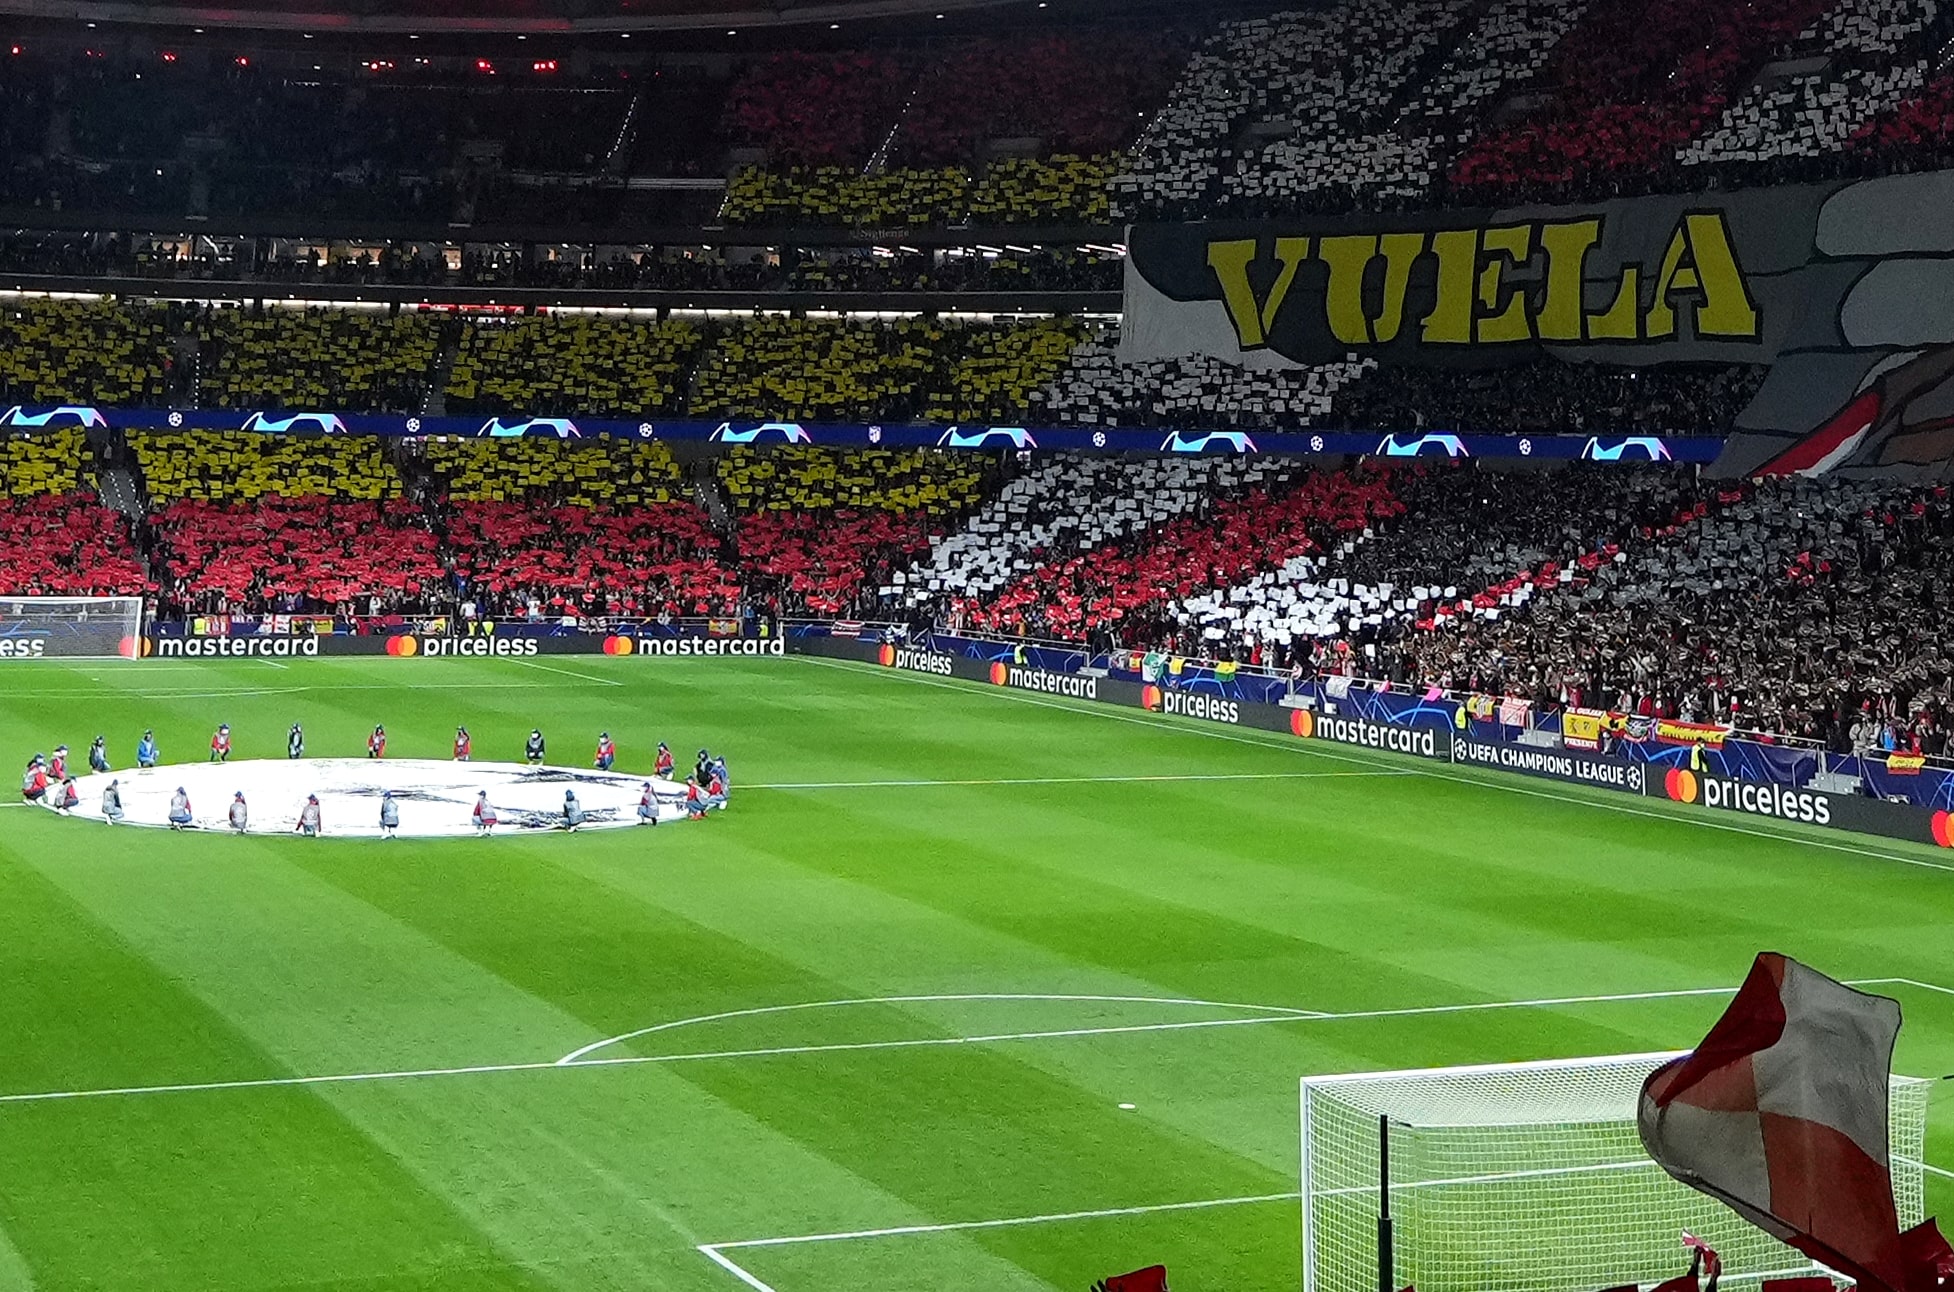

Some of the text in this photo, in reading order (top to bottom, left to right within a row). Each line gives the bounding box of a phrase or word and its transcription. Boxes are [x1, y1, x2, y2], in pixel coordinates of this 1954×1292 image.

[1207, 214, 1756, 347] VUELA
[158, 634, 319, 656] mastercard
[423, 634, 538, 657] priceless
[639, 634, 785, 656] mastercard
[895, 648, 952, 675] priceless
[1009, 667, 1097, 699] mastercard
[1164, 689, 1239, 723] priceless
[1317, 716, 1434, 756] mastercard
[1468, 743, 1625, 785] UEFA CHAMPIONS LEAGUE
[1703, 777, 1830, 824] priceless
